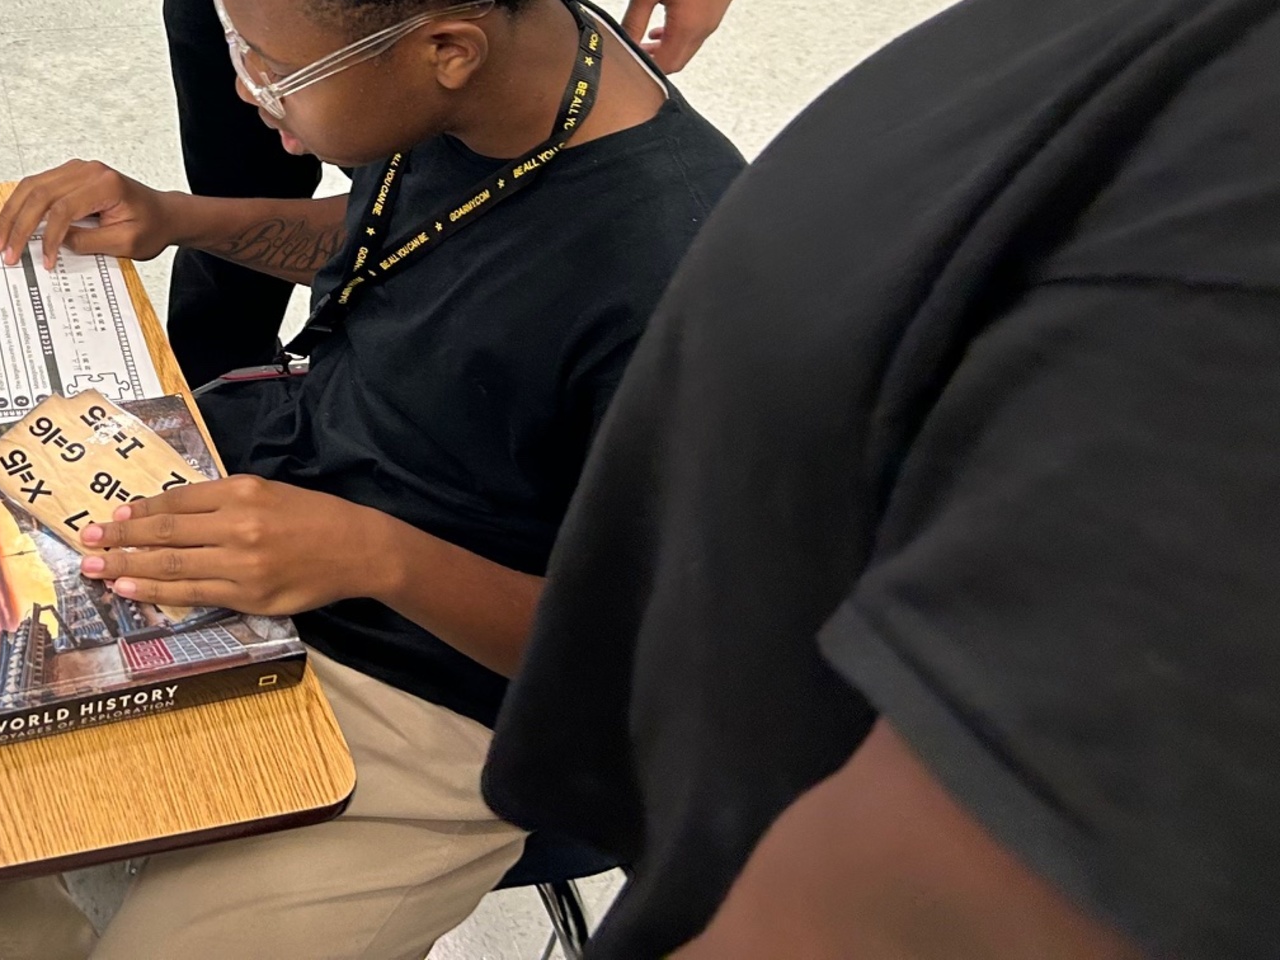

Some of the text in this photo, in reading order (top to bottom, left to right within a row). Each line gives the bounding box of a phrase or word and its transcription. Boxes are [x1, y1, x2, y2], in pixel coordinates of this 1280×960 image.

[576, 80, 588, 96] BE
[569, 97, 583, 114] ALL
[384, 168, 396, 187] YOU
[513, 164, 524, 179] BE
[523, 158, 540, 173] ALL
[378, 185, 389, 205] CAN
[372, 202, 383, 216] BE
[379, 259, 391, 270] BE
[28, 286, 53, 354] SECRET MESSAGE
[29, 416, 86, 463] G=16
[80, 685, 179, 716] HISTORY
[57, 720, 75, 730] OF
[80, 700, 175, 725] EXPLORATION
